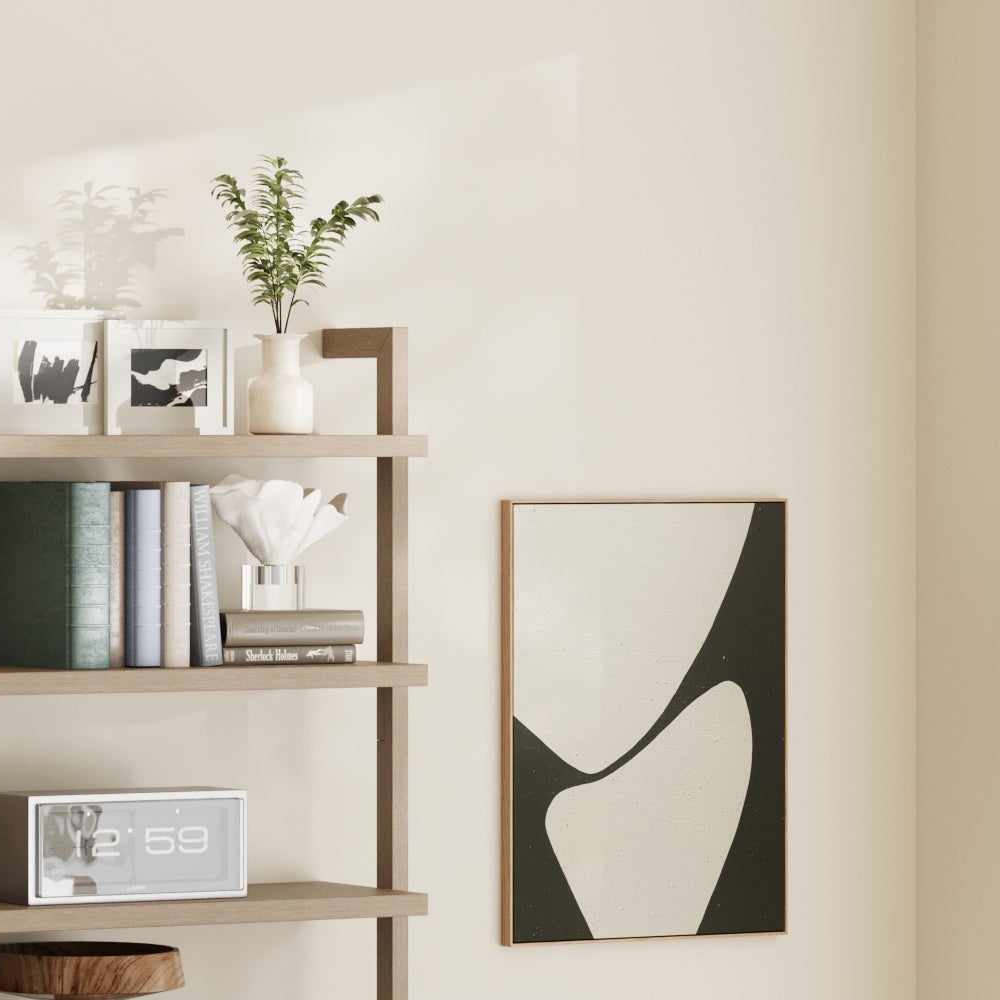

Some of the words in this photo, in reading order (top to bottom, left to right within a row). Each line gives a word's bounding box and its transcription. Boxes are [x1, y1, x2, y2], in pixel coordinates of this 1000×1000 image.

[193, 489, 210, 556] WILLIAM
[199, 560, 218, 663] SHAKESPEARE
[245, 648, 273, 662] Sherlock
[275, 648, 298, 661] Holmes
[145, 826, 208, 855] 59
